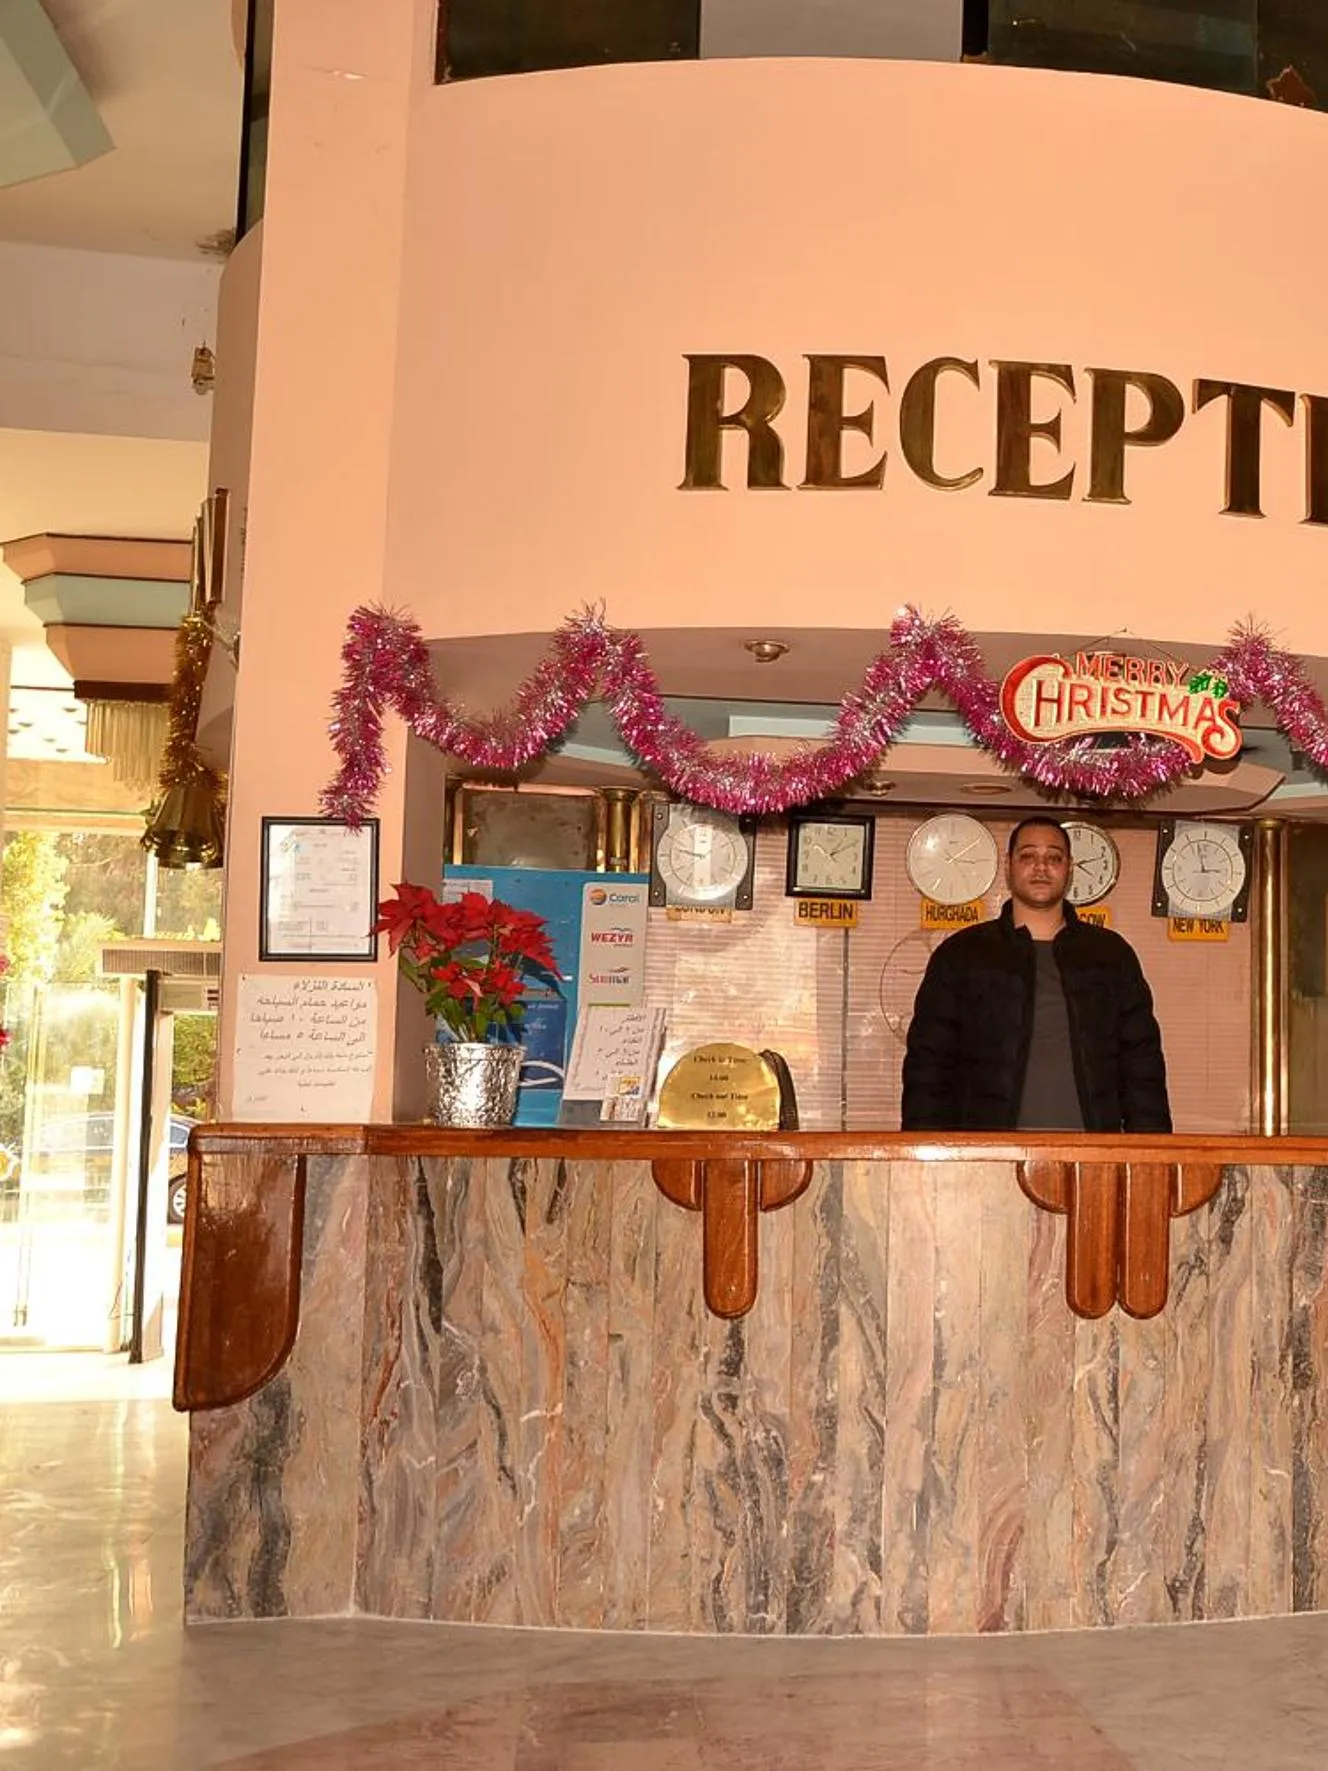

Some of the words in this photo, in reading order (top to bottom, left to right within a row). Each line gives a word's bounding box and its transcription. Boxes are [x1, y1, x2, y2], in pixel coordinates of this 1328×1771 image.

[1076, 652, 1189, 687] MERRY
[1000, 655, 1242, 764] CHRISTMAS
[609, 893, 640, 903] Coral
[799, 902, 852, 919] BERLIN
[925, 905, 978, 921] HURGHADA
[1173, 917, 1195, 933] NEW
[1199, 918, 1225, 934] YORK
[591, 932, 633, 943] WEZYR
